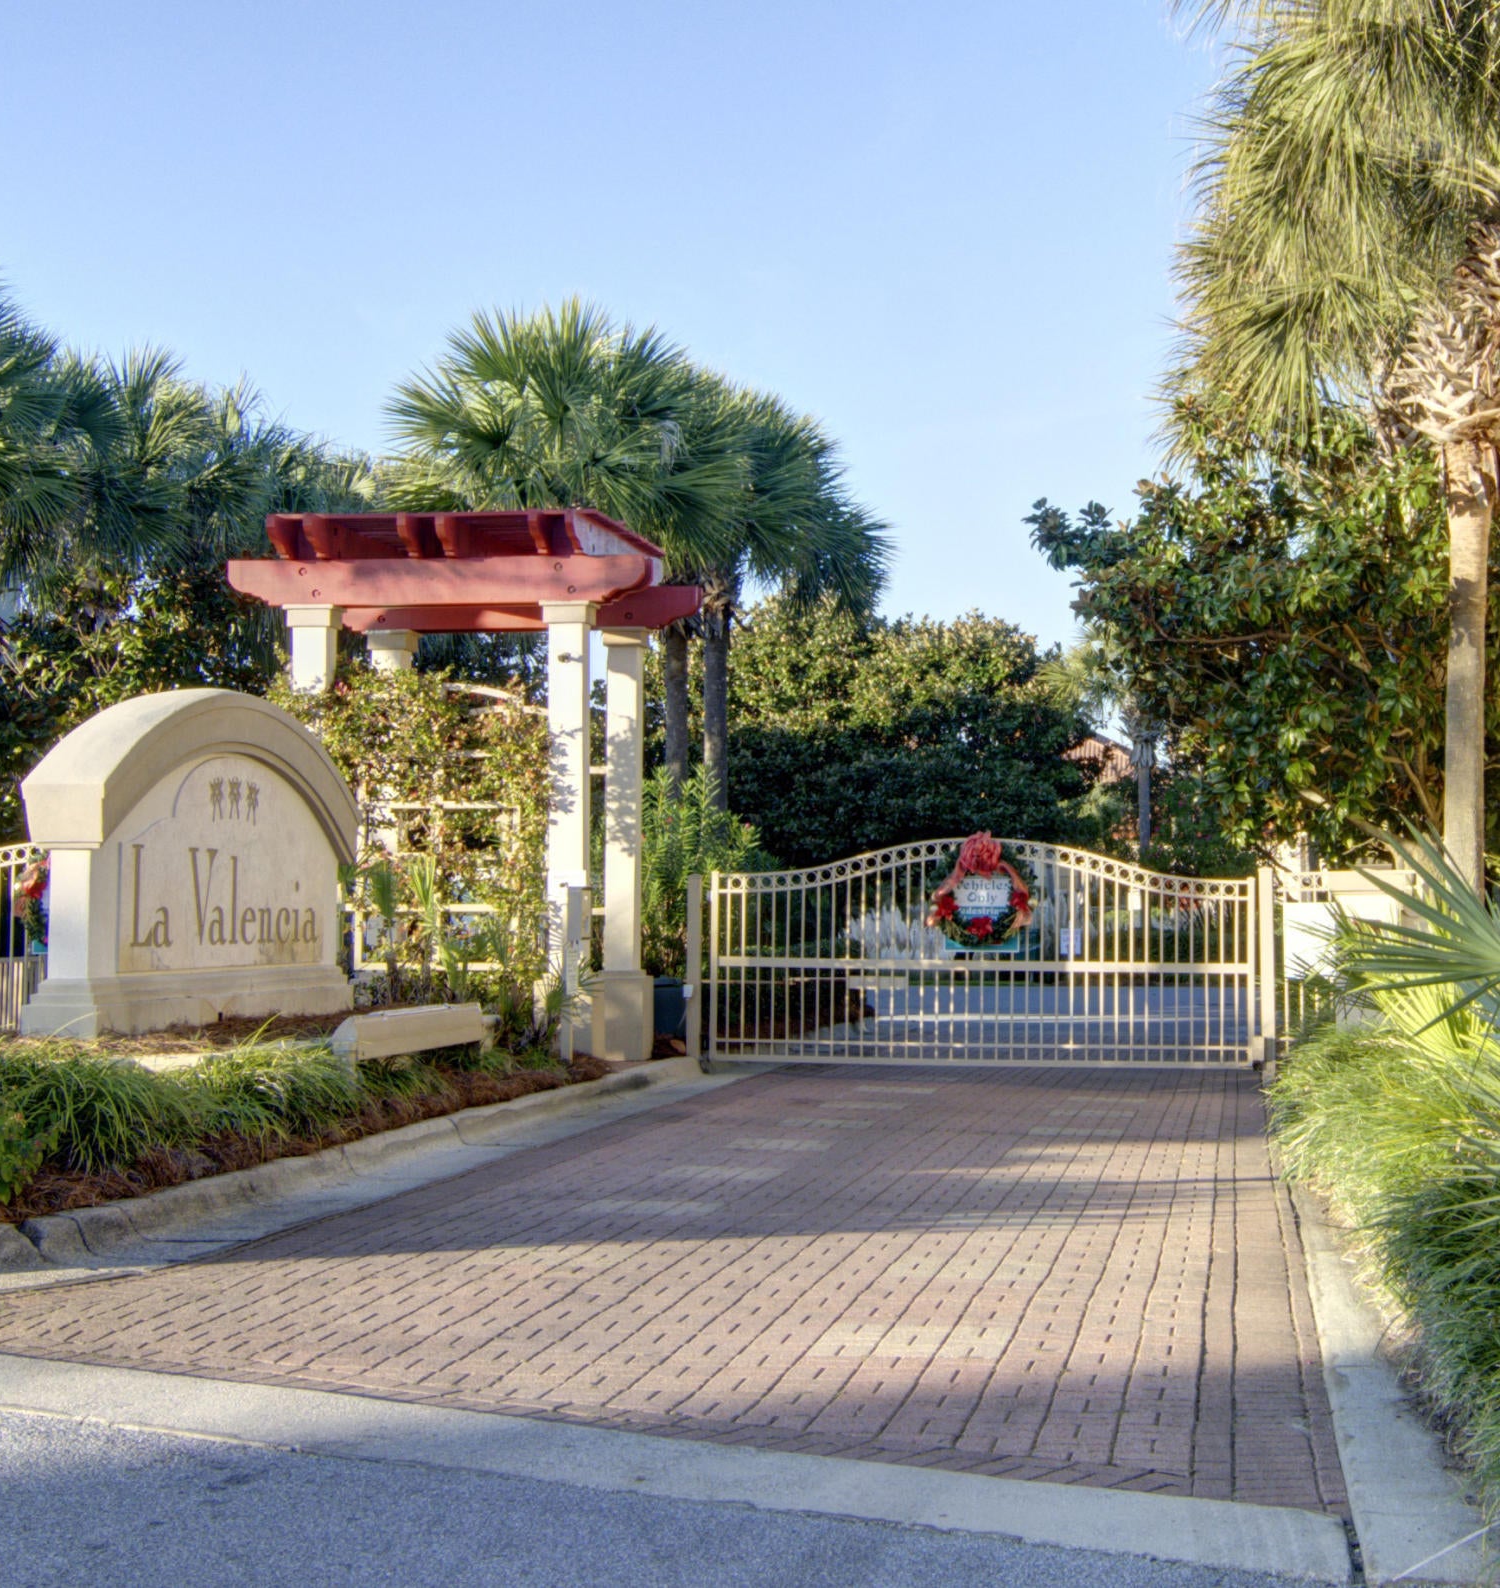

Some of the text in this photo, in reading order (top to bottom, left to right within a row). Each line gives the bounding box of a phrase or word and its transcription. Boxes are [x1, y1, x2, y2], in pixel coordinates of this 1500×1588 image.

[130, 844, 318, 948] La Valencia
[967, 891, 997, 904] Only
